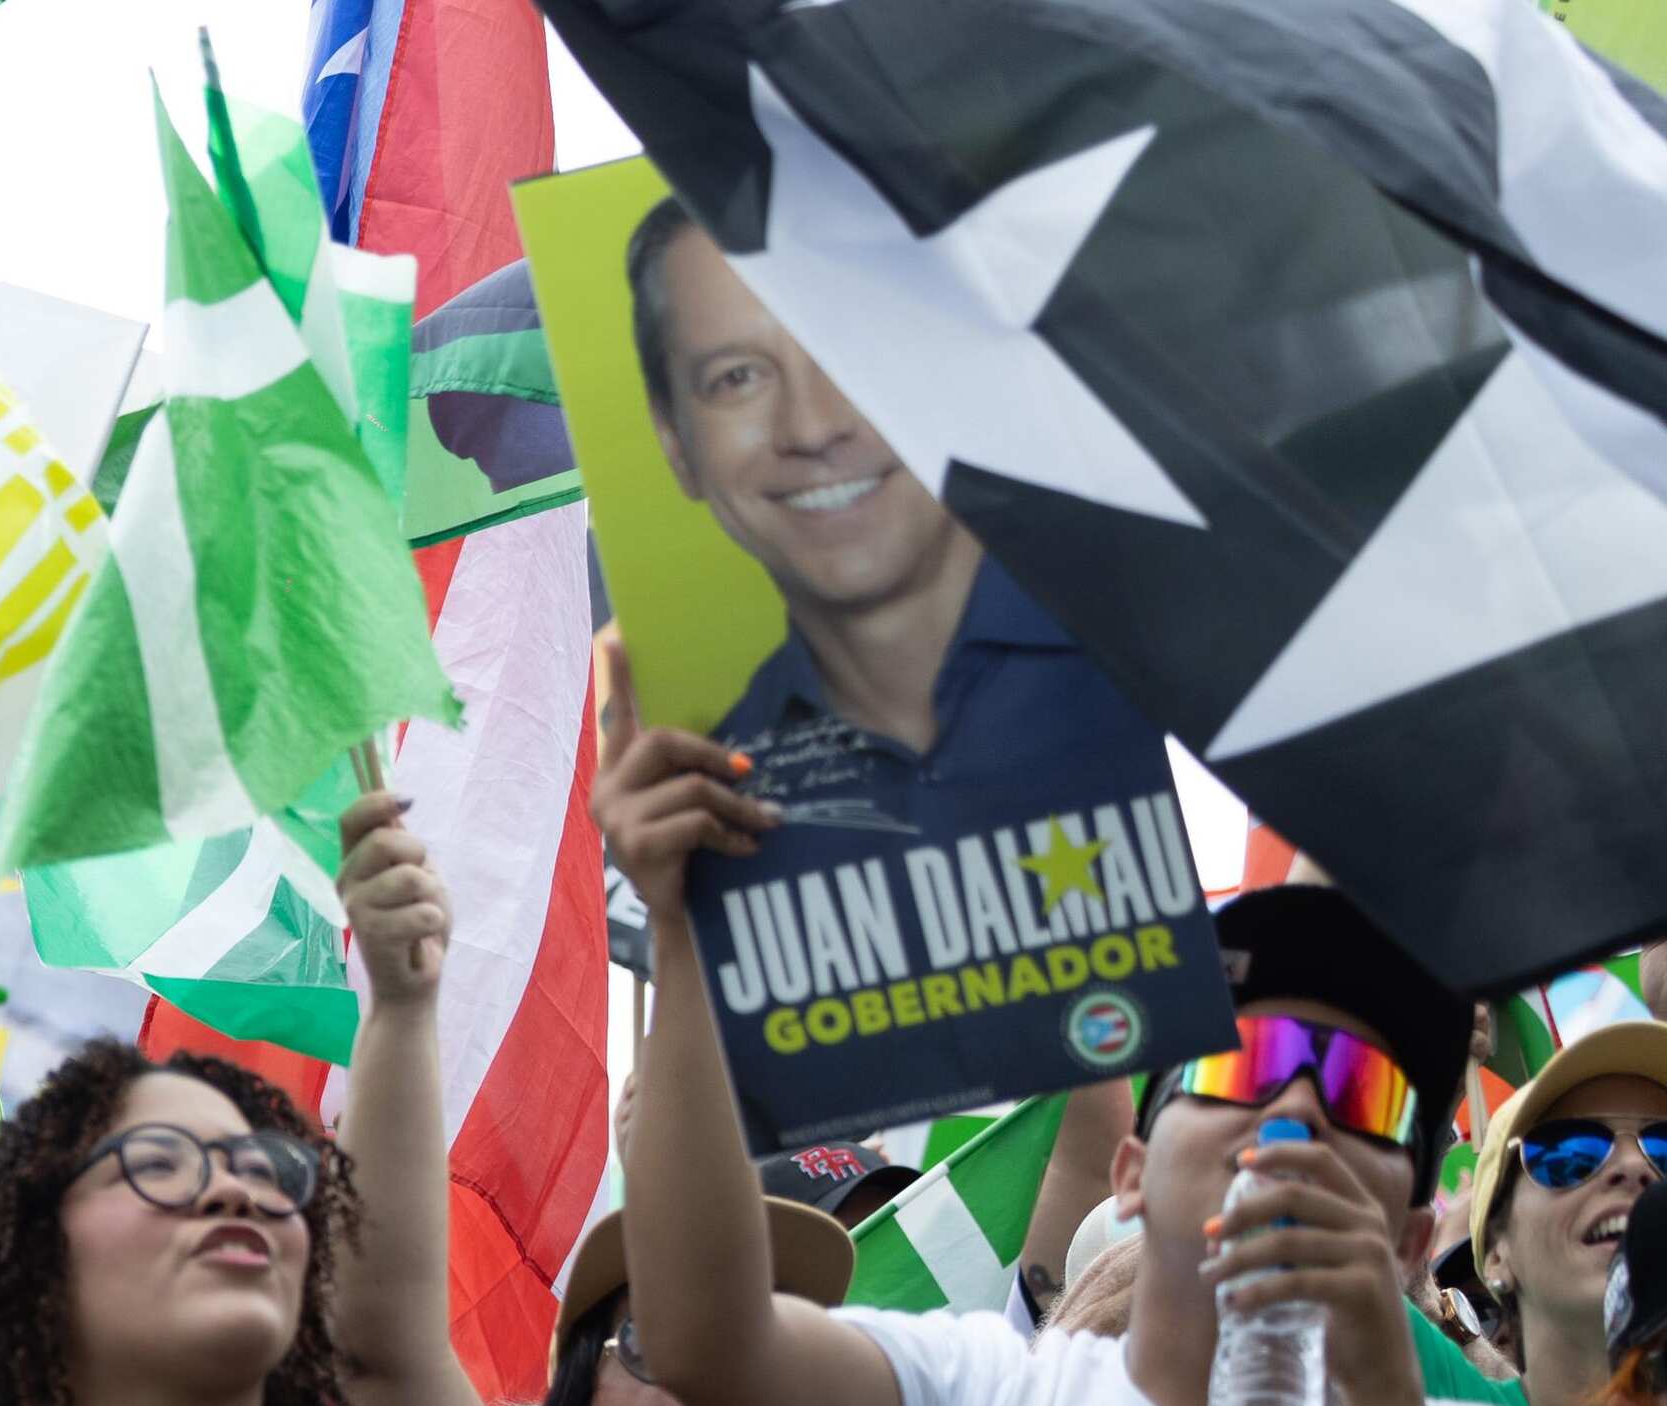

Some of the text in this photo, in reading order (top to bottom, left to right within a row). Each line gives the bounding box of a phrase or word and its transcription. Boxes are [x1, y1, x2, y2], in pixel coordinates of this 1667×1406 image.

[718, 791, 1195, 1014] JUAN DALMAU
[763, 925, 1179, 1054] GOBERNADOR
